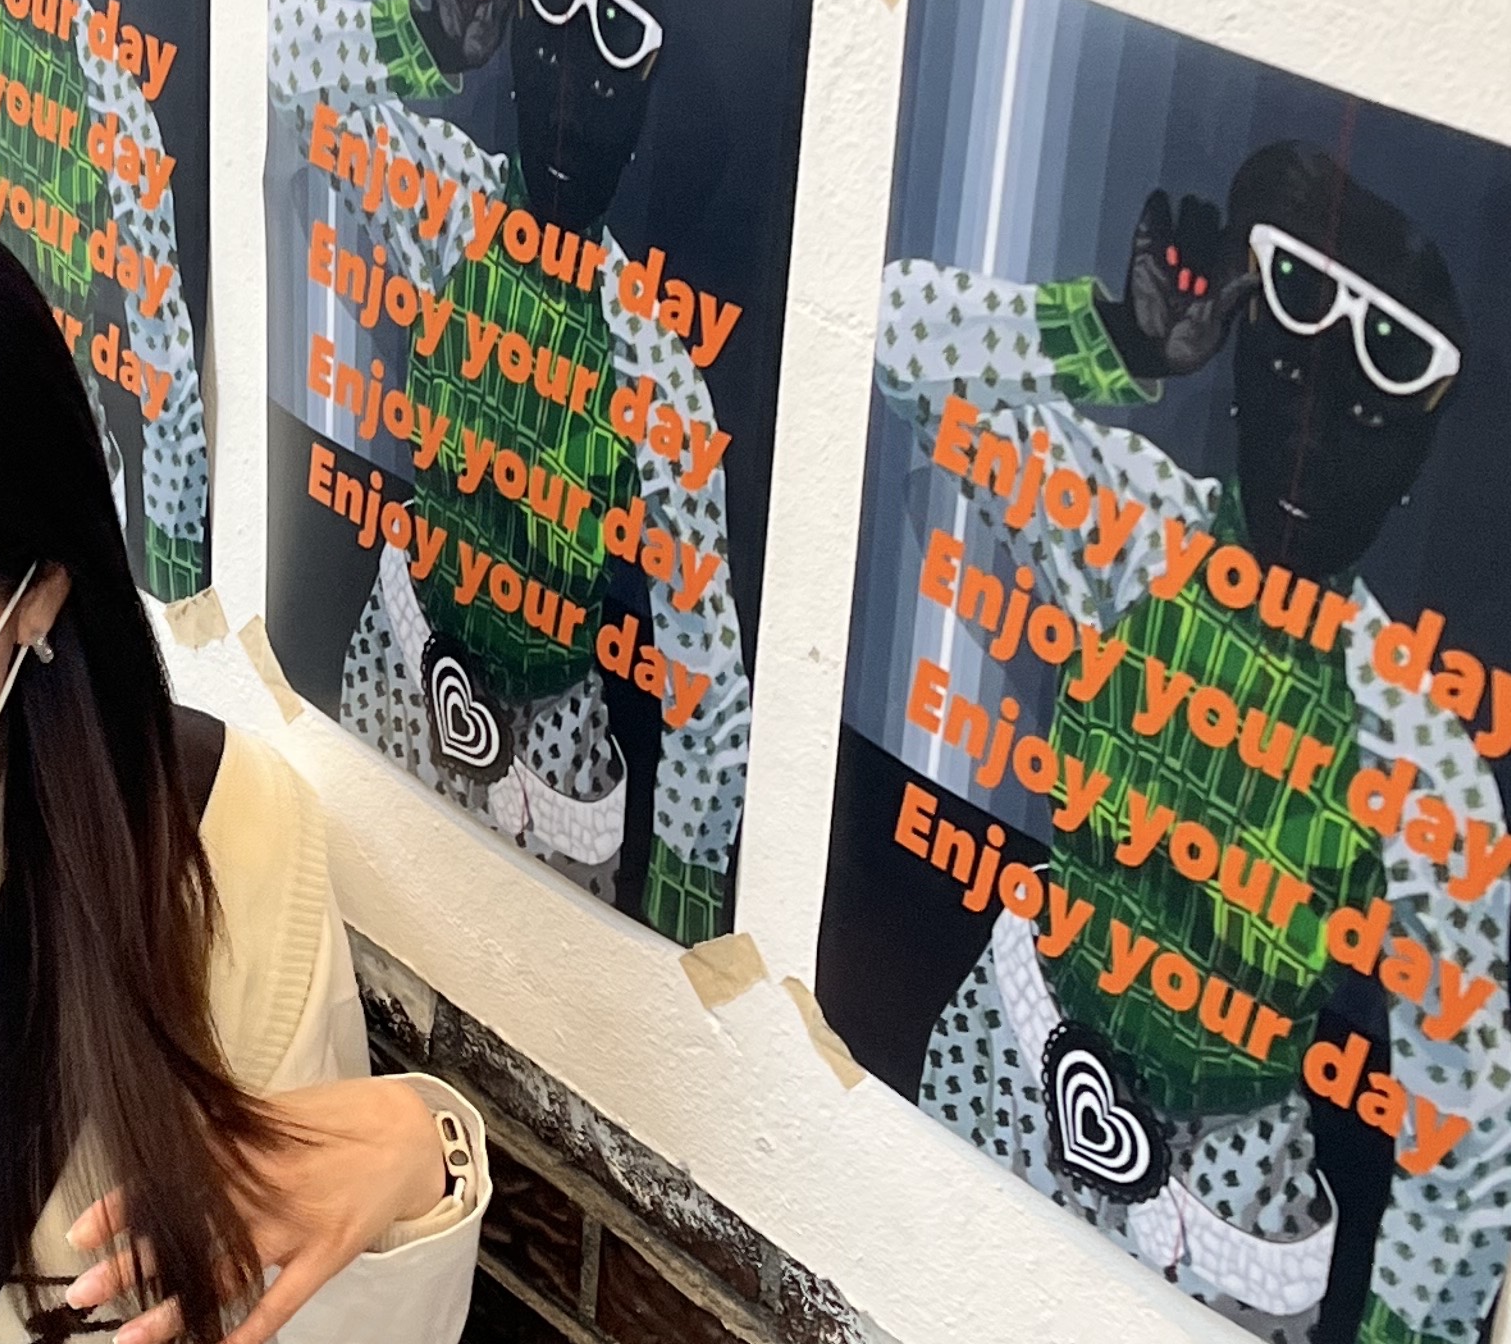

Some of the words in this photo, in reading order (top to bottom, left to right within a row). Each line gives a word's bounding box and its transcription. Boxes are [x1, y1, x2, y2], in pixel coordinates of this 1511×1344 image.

[88, 112, 176, 211] day
[89, 219, 173, 317] day
[308, 102, 458, 240] Enjoy
[465, 189, 608, 293] your
[618, 248, 743, 369] day
[91, 323, 172, 422] day
[306, 335, 451, 471] Enjoy
[458, 429, 594, 533] your
[602, 497, 722, 613] day
[308, 220, 455, 358] Enjoy
[461, 312, 601, 415] your
[609, 375, 731, 492] day
[307, 443, 449, 581] Enjoy
[454, 542, 588, 647] your
[595, 615, 712, 730] day
[918, 528, 1129, 704] Enjoy
[1132, 656, 1337, 794] your
[1345, 757, 1511, 903] day
[932, 395, 1146, 569] Enjoy
[1150, 518, 1360, 654] your
[1373, 609, 1511, 760] day
[894, 783, 1096, 960] Enjoy
[1097, 921, 1294, 1061] your
[1301, 1034, 1471, 1176] day
[906, 657, 1112, 834] Enjoy
[1115, 789, 1315, 929] your
[1325, 897, 1497, 1042] day
